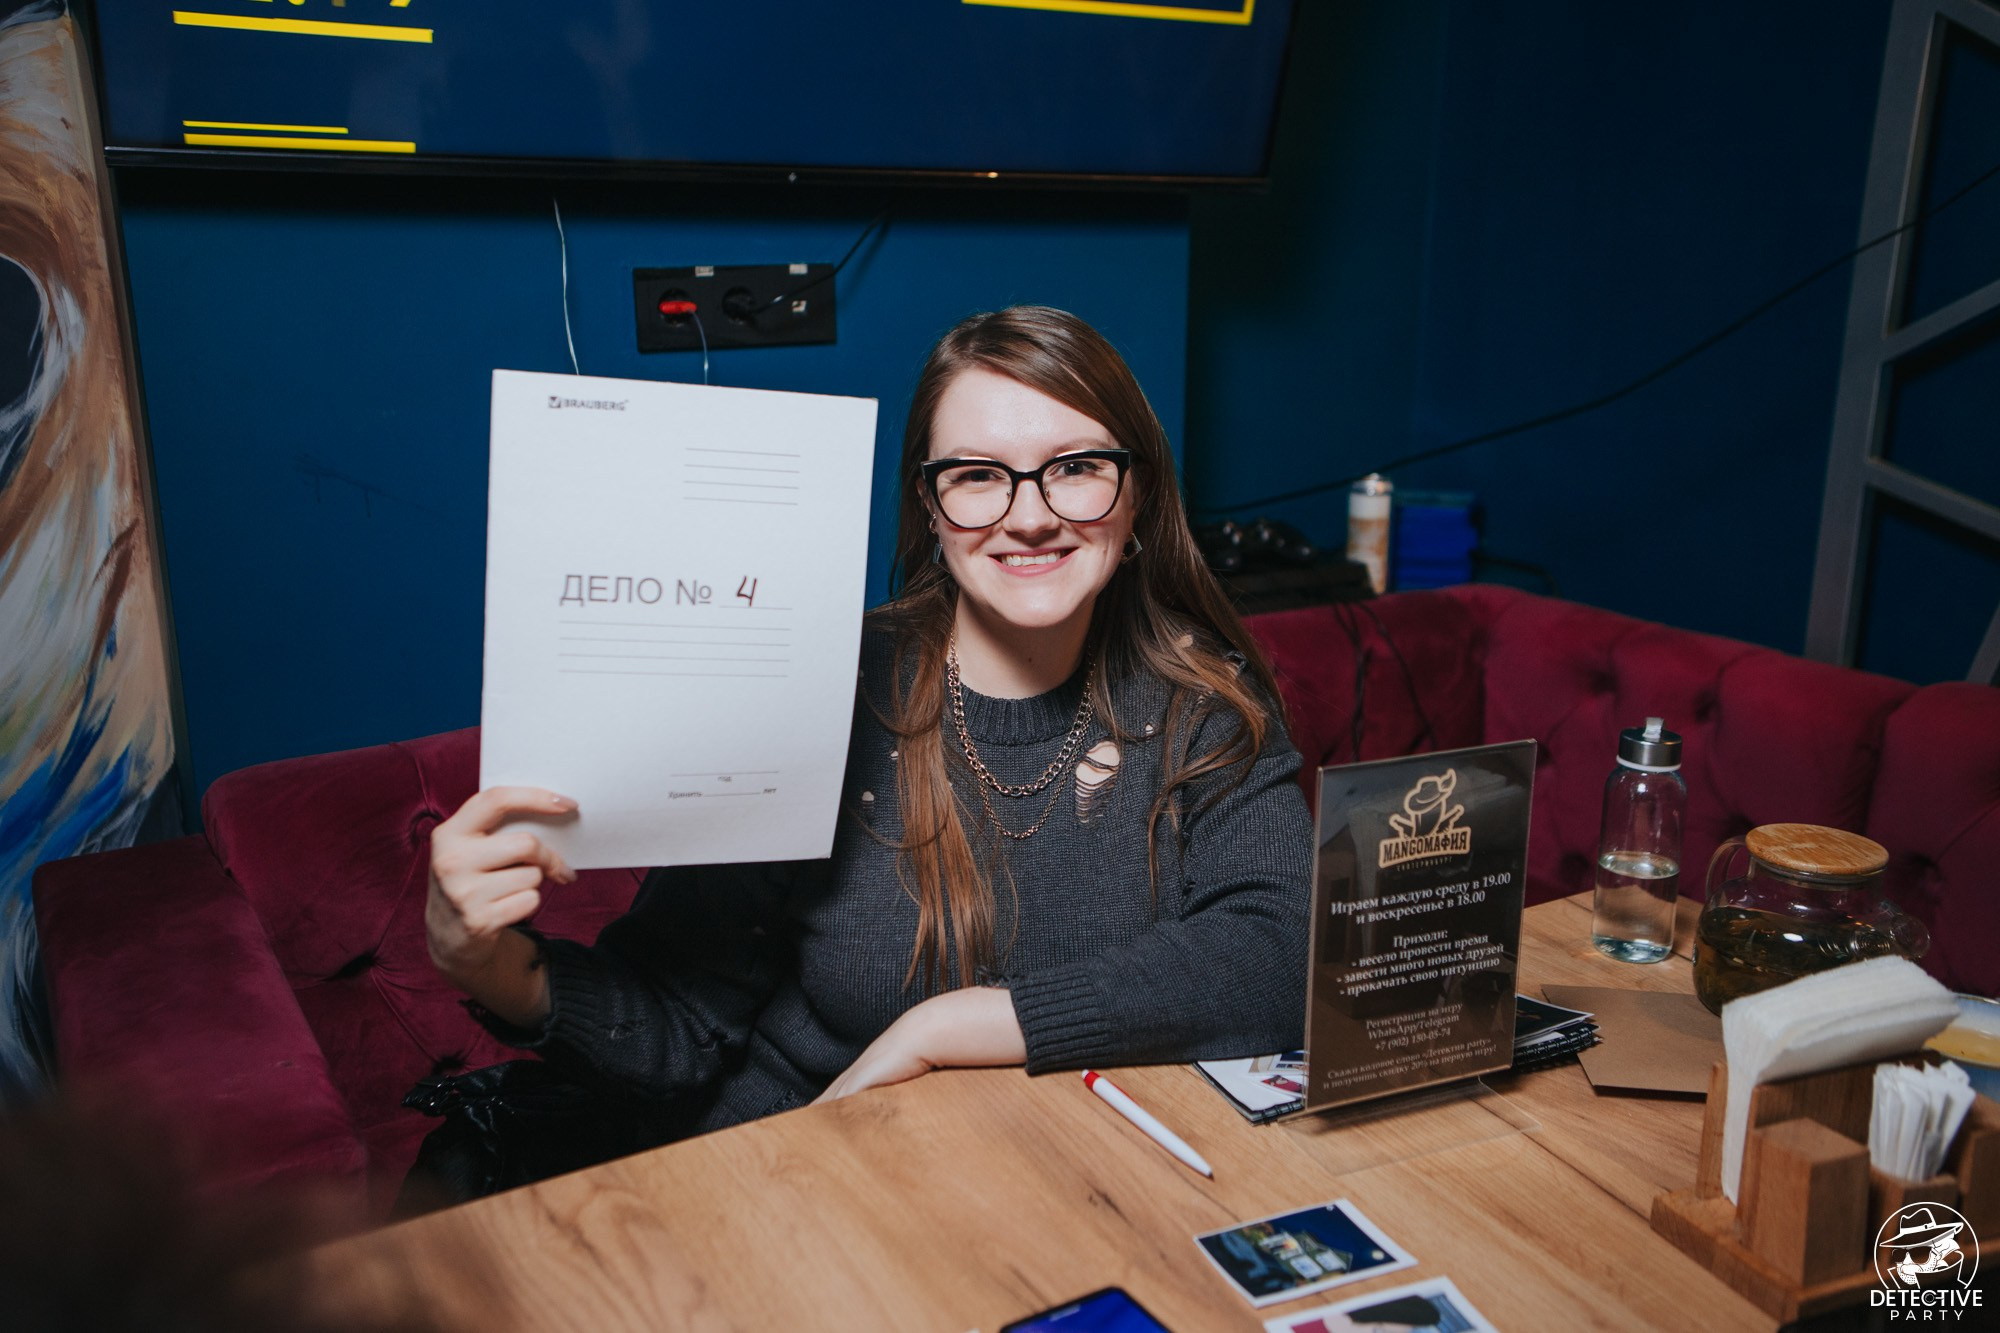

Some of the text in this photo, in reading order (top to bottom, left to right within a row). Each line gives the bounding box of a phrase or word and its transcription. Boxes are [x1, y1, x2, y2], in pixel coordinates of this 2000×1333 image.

[559, 574, 712, 606] ДЕЛО №
[736, 575, 757, 607] 4
[1331, 872, 1511, 916] Играем каждую среду в 19.00
[1356, 890, 1486, 925] и воскресенье в 18.00
[1359, 952, 1397, 967] весело
[1399, 941, 1452, 961] провести
[1454, 934, 1489, 950] время
[1393, 929, 1448, 949] Приходи:
[1344, 967, 1387, 984] завести
[1390, 961, 1425, 975] много
[1427, 951, 1464, 968] новых
[1465, 942, 1504, 960] друзей
[1347, 976, 1408, 997] прокачать
[1410, 970, 1439, 983] свою
[1441, 957, 1500, 977] интуицию
[1366, 1011, 1426, 1030] Регистрация
